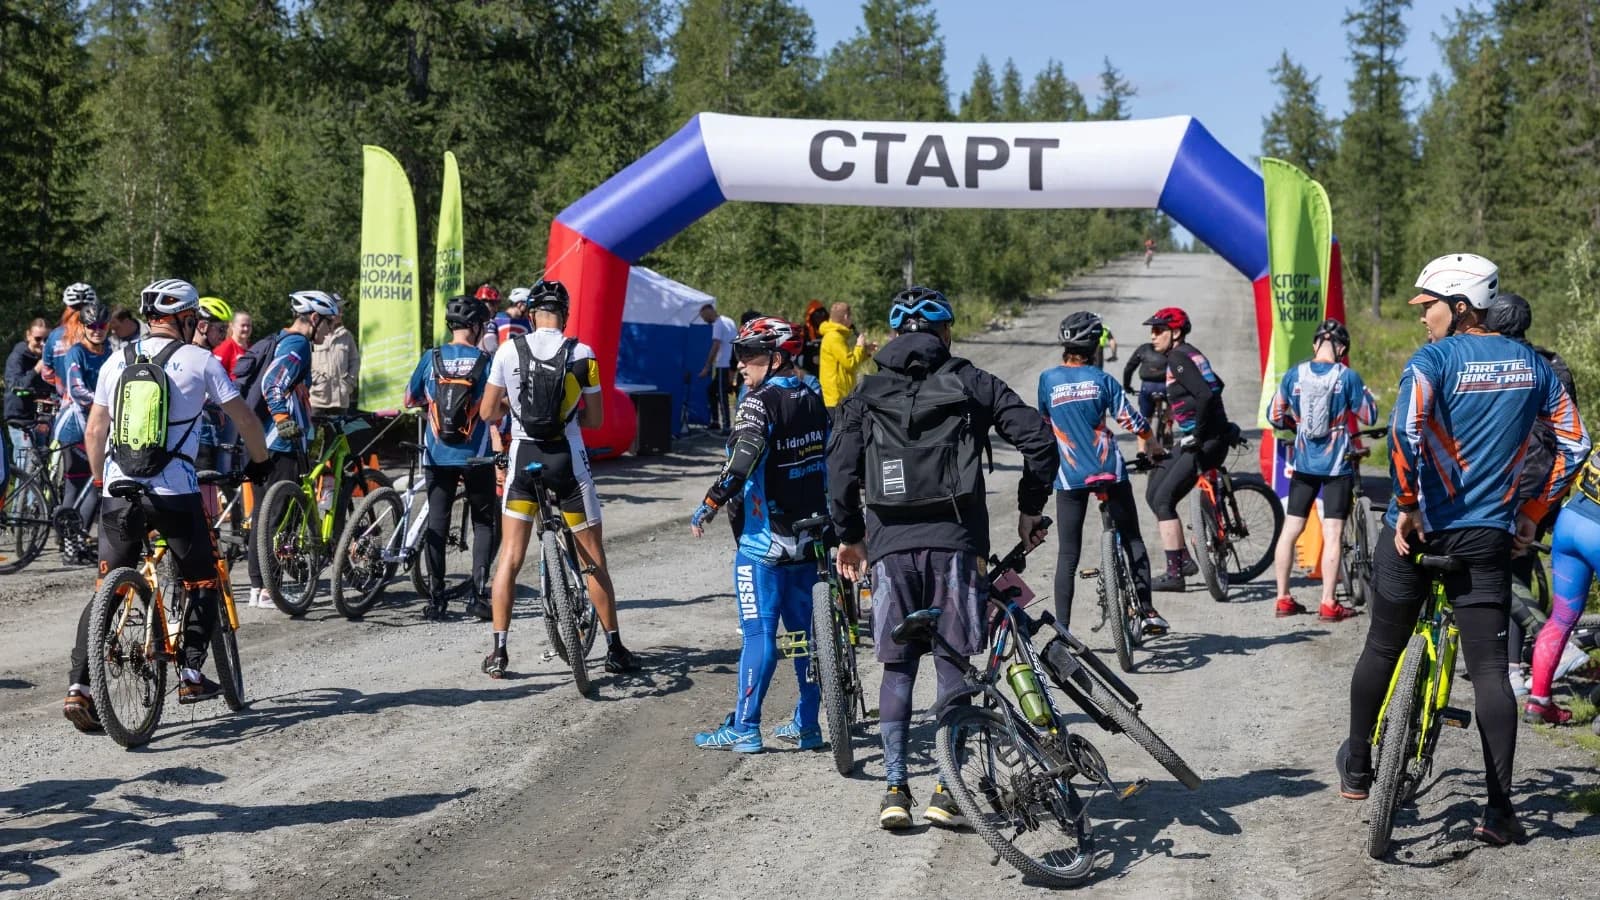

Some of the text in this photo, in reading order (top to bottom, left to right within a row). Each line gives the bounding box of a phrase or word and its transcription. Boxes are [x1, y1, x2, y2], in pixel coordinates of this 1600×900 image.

[809, 129, 1060, 191] СТАРТ
[361, 269, 413, 285] НОРМА
[361, 285, 413, 301] ЖИЗНИ
[1468, 361, 1526, 373] ARCTIC
